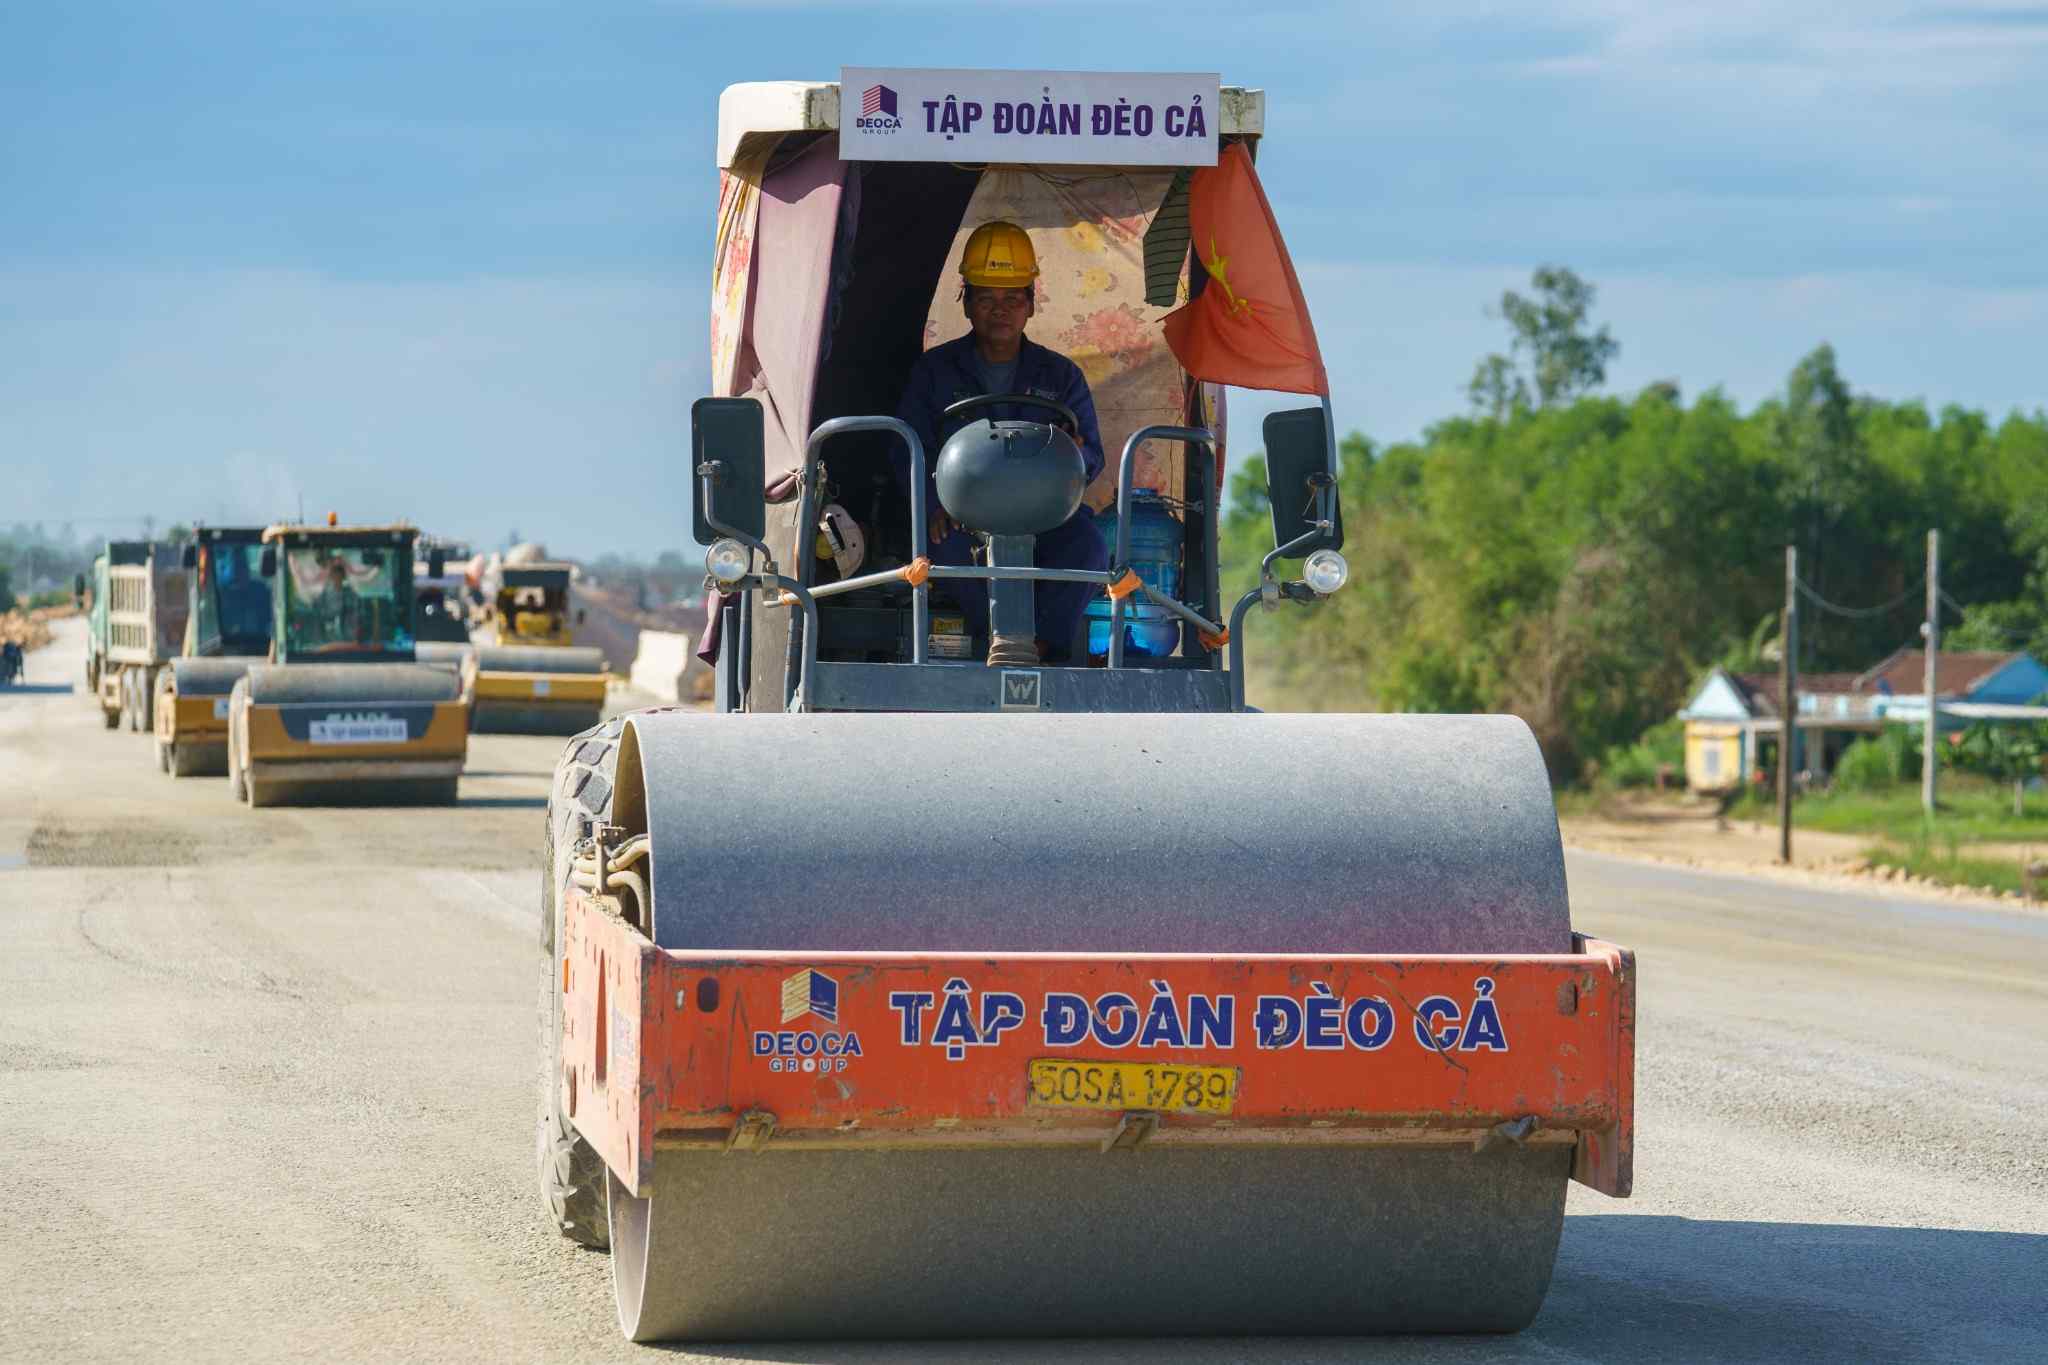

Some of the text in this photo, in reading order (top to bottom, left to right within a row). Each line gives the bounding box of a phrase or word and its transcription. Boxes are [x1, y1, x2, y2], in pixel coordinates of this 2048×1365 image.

[856, 117, 902, 128] DEOCA
[922, 94, 1207, 140] TẬP ĐOÀN ĐÈO CẢ
[889, 977, 1508, 1061] TẬP ĐOÀN ĐÈO CẢ
[754, 1031, 863, 1057] DEOCA
